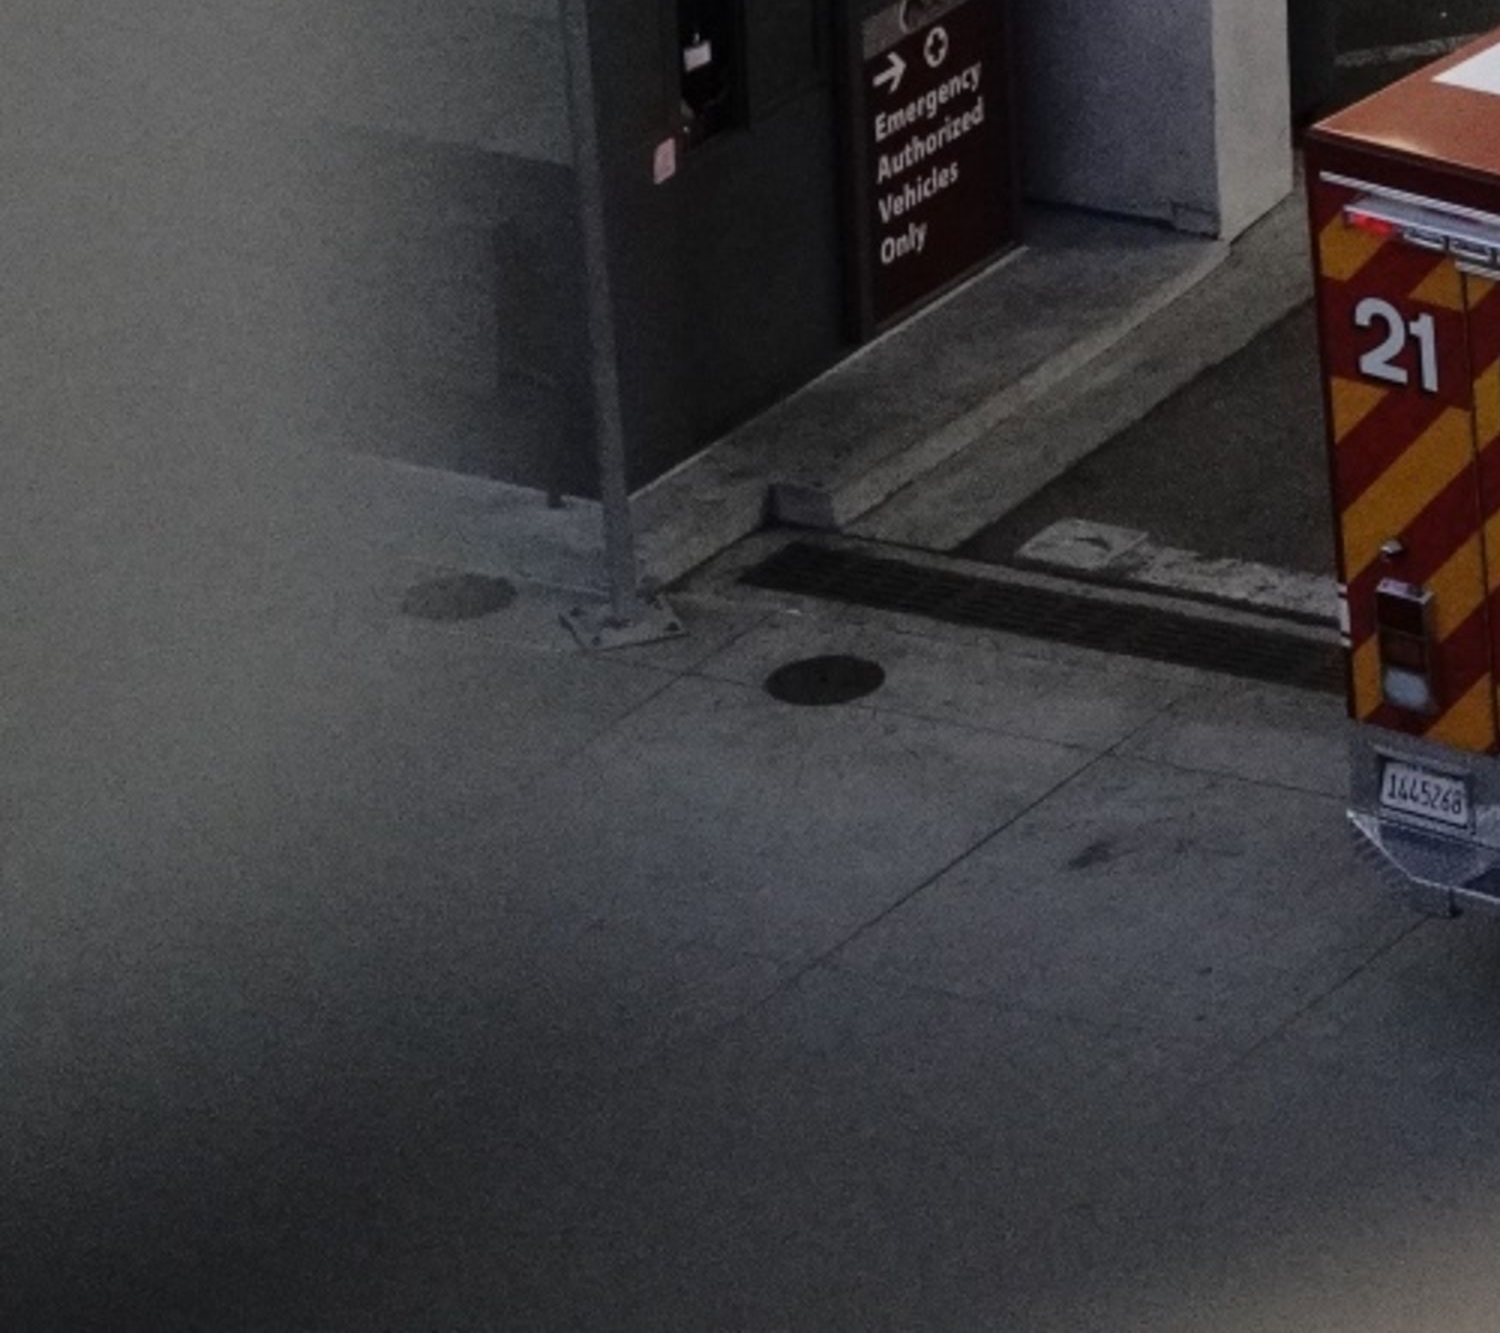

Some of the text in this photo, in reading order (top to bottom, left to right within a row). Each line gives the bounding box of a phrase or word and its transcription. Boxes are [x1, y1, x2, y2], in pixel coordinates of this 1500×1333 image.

[875, 62, 982, 142] Emergency
[878, 96, 984, 183] Authorized
[878, 162, 959, 223] Vehicles
[881, 222, 927, 264] Only
[1354, 296, 1438, 392] 21
